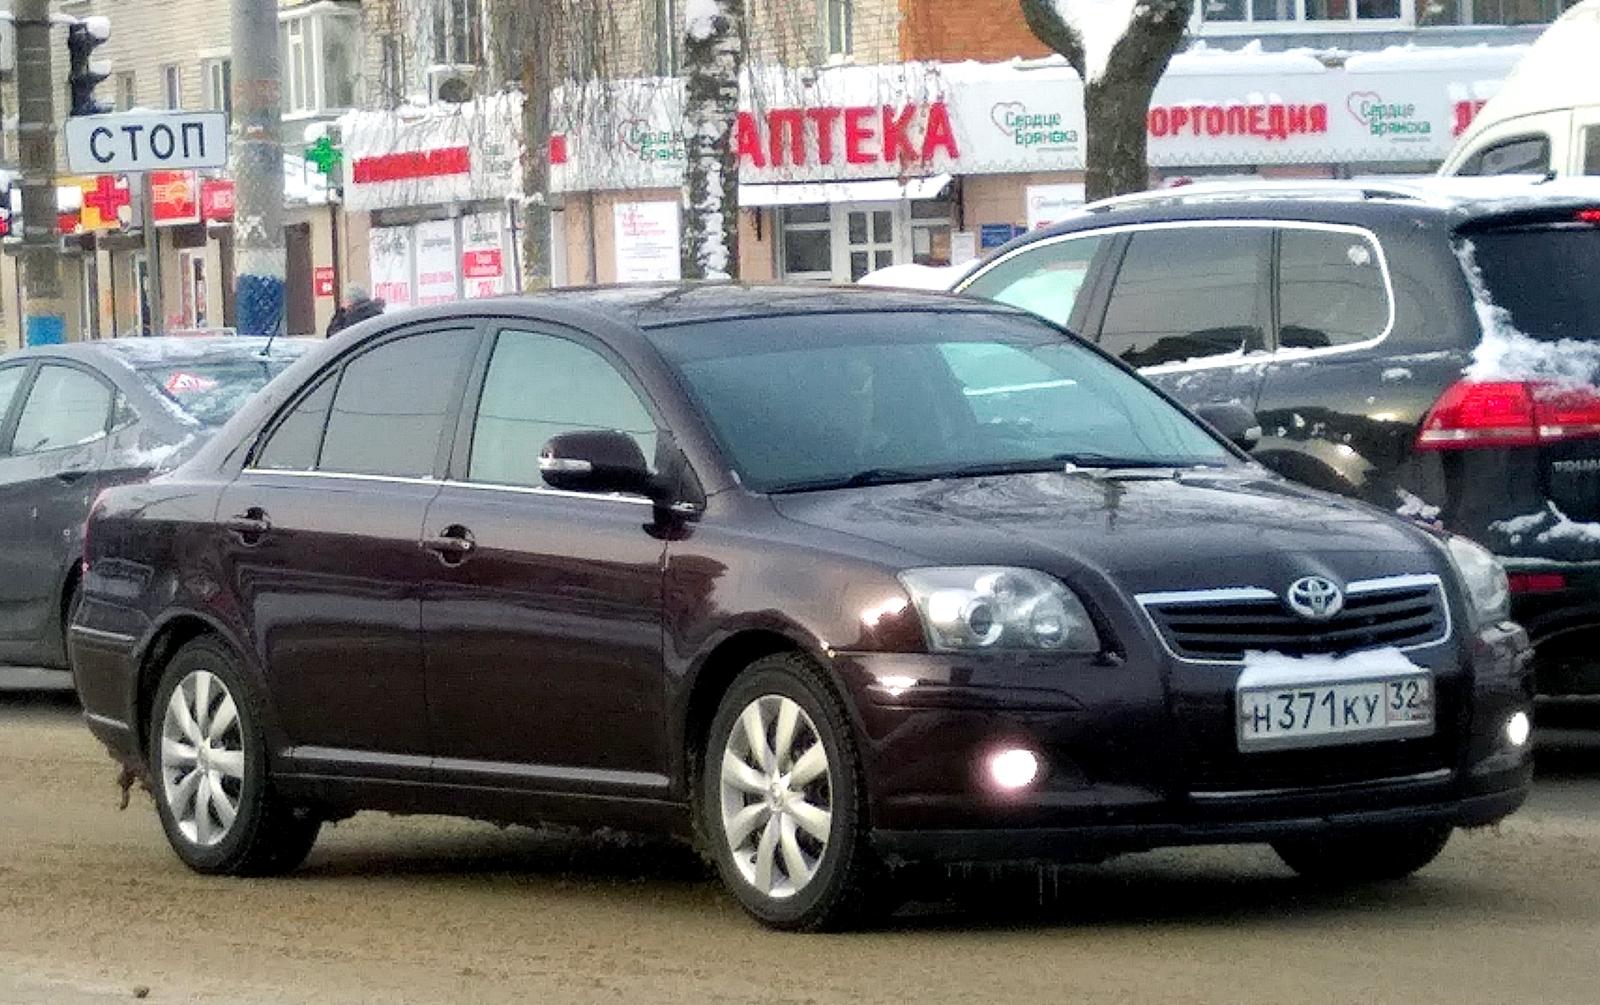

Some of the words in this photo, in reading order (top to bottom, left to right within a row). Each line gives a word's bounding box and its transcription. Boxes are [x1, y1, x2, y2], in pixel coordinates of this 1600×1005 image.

[1005, 111, 1062, 128] Сердце
[1148, 103, 1328, 140] ОРТОПЕДИЯ
[1360, 100, 1415, 119] Сердце
[735, 102, 960, 169] АПТЕКА
[1015, 128, 1079, 148] Брянска
[1370, 117, 1431, 136] Брянска
[90, 122, 206, 163] СТОП
[1254, 692, 1379, 732] Н371КУ
[1390, 680, 1420, 711] 32
